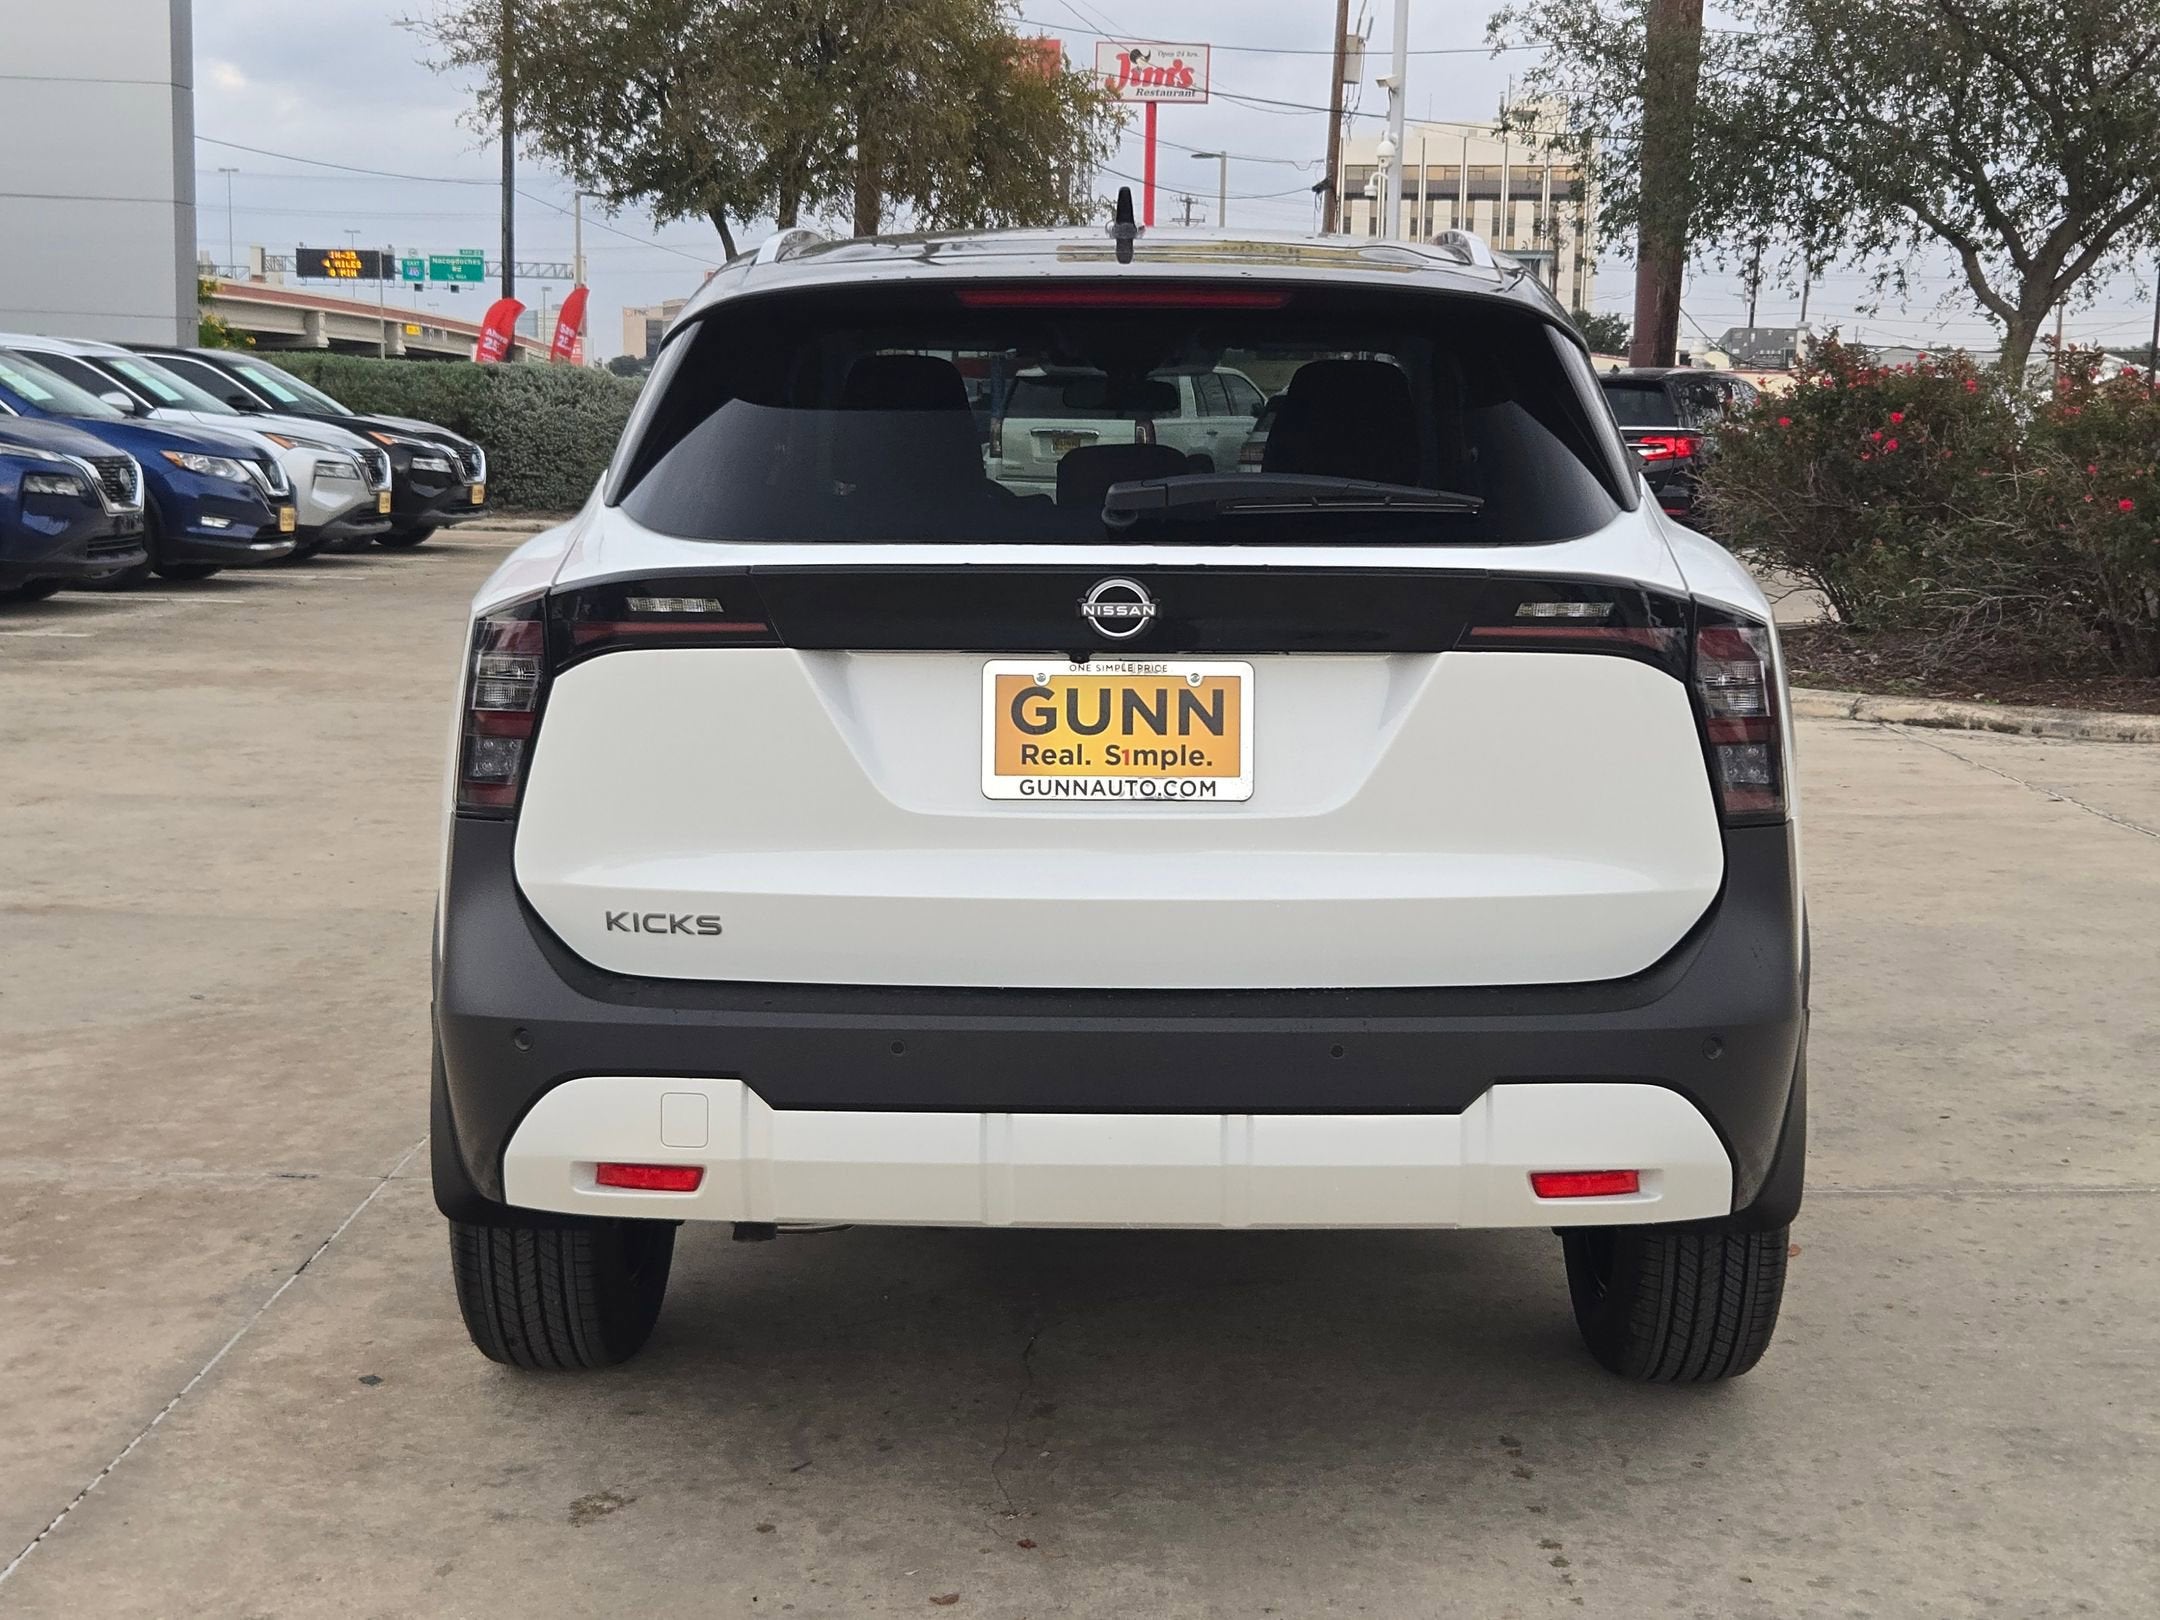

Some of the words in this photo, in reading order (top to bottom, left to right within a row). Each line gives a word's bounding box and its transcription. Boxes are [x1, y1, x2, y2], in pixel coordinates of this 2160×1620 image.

[1157, 50, 1175, 58] Open
[1104, 52, 1195, 92] Jim's
[1136, 88, 1196, 98] Restaurant
[335, 260, 362, 270] MILES
[1083, 605, 1155, 616] NISSAN
[1069, 664, 1091, 672] ONE
[1096, 664, 1134, 673] SIMPLE
[1137, 664, 1168, 674] PRICE
[1011, 687, 1224, 736] GUNN
[1021, 743, 1091, 767] Real.
[1019, 778, 1217, 798] GUNNAUTO.COM
[605, 911, 723, 936] KICKS
